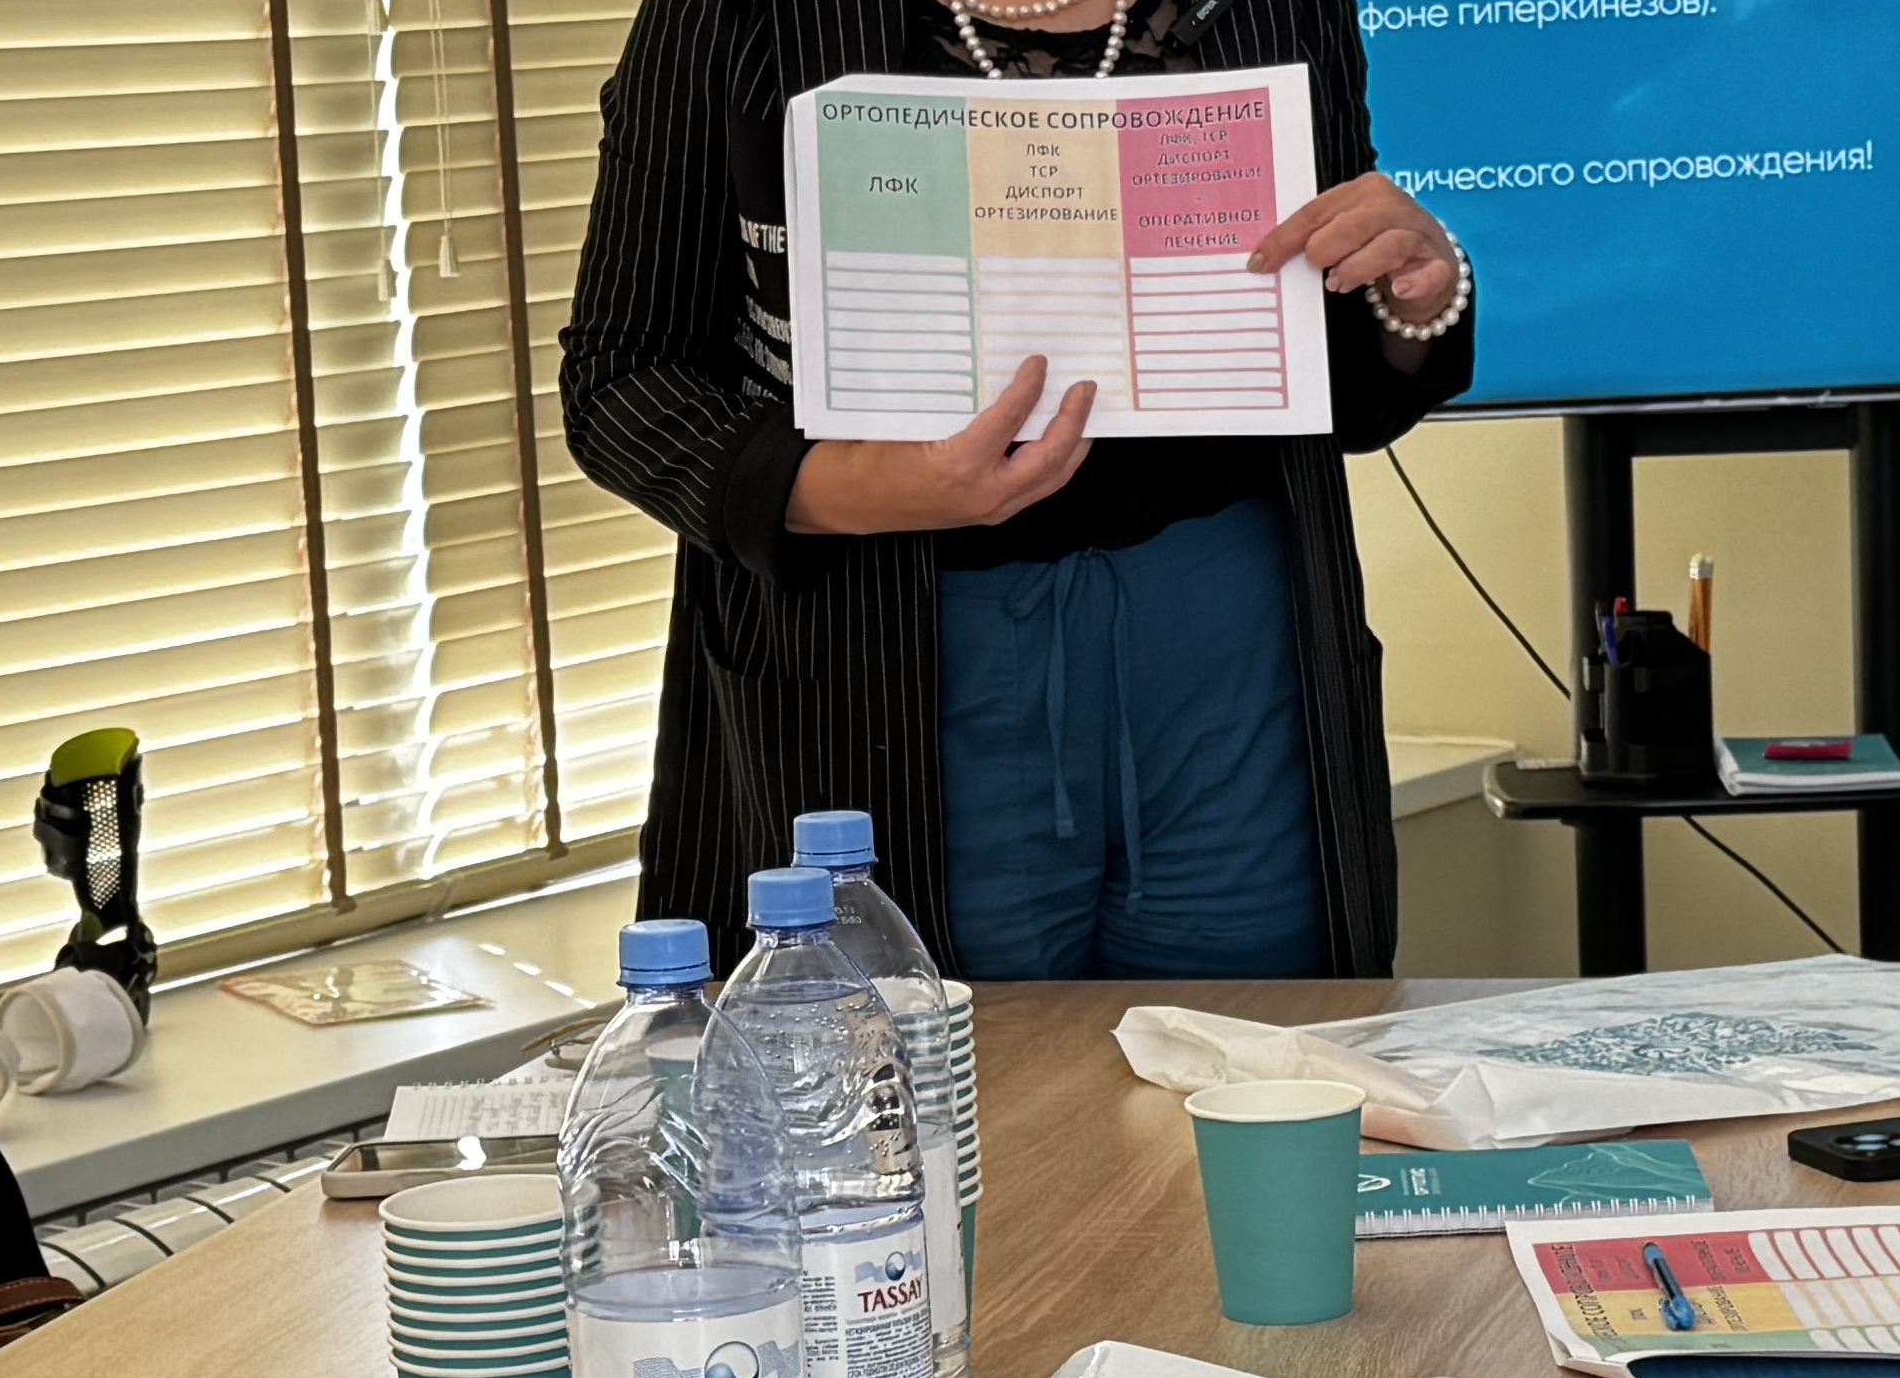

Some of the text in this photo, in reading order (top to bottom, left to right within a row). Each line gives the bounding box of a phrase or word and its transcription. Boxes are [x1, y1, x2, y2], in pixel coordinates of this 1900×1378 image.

[1359, 0, 1449, 34] фоне
[822, 100, 1265, 131] ОРТОПЕДИЧЕСКОЕ СОПРОВОЖДЕНИЕ
[1026, 142, 1061, 158] ЛФК
[1030, 164, 1059, 178] ТСР
[1391, 139, 1874, 197] дического сопровождения!
[869, 175, 919, 196] ЛФК
[1005, 184, 1085, 201] ДИСПОРТ
[974, 206, 1119, 222] ОРТЕЗИРОВАНИЕ
[1138, 208, 1262, 228] ОПЕРАТИВНОЕ
[1163, 231, 1240, 249] ЛЕЧЕНИЕ
[857, 1276, 923, 1314] TASSAY
